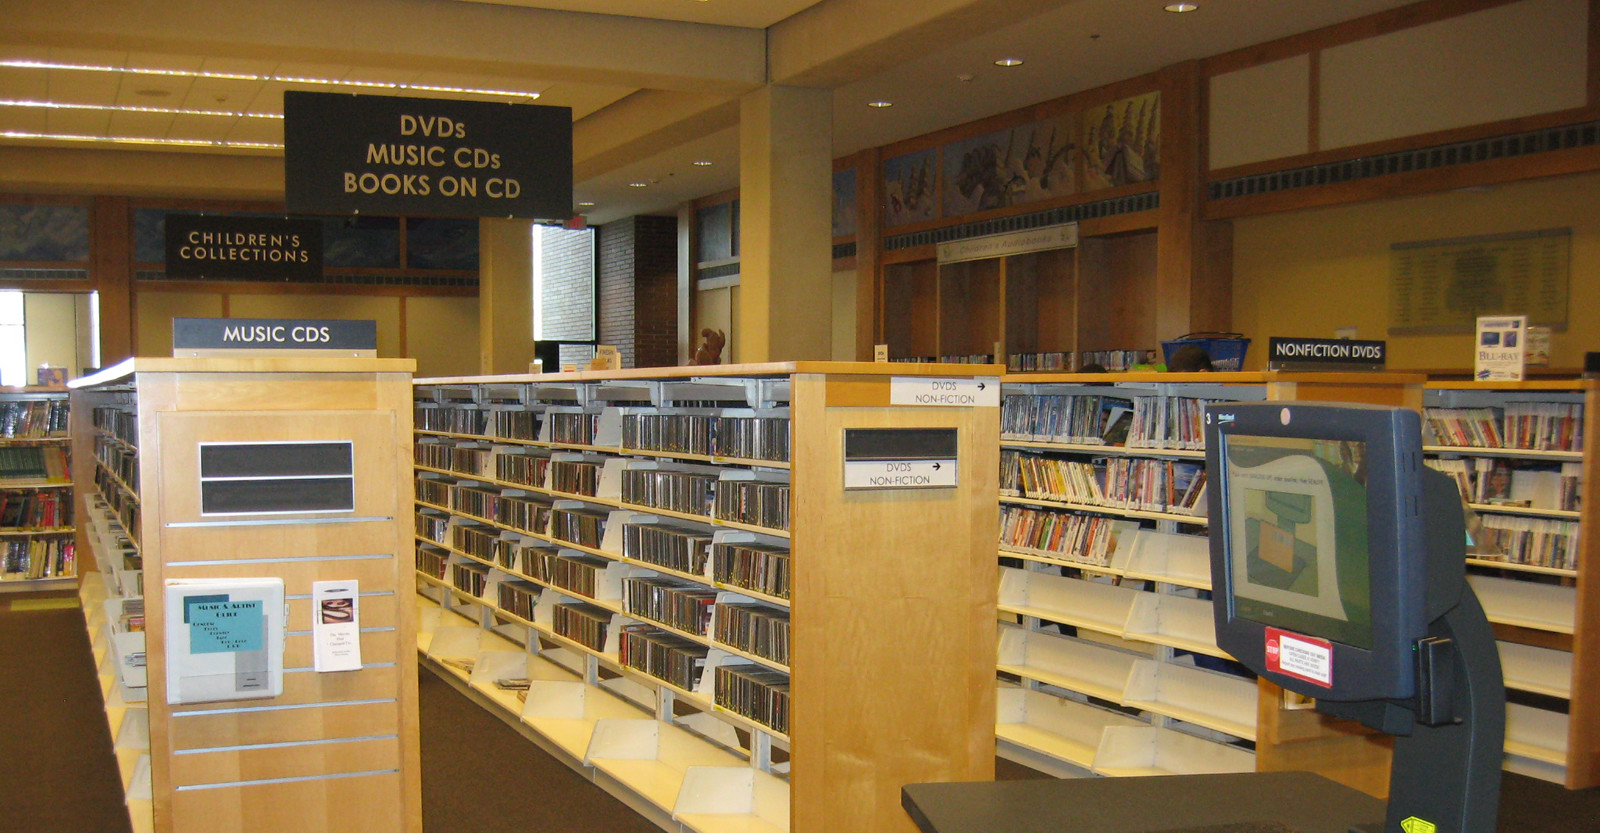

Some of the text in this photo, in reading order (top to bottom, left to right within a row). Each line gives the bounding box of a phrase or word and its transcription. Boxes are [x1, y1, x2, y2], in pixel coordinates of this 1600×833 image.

[400, 114, 466, 139] DVDs
[366, 143, 501, 169] MUSIC CDs
[344, 172, 521, 199] BOOKS ON CD
[189, 231, 300, 248] CHILDREN'S
[180, 246, 309, 263] COLLECTIONS
[223, 326, 330, 342] MUSIC CDS
[1276, 343, 1381, 359] NONFICTION DVDS
[931, 381, 957, 391] DVDS
[915, 394, 975, 404] NON-FICTION
[1205, 412, 1211, 425] 3
[886, 463, 912, 472] DVDS
[869, 475, 930, 486] NON-FICTION
